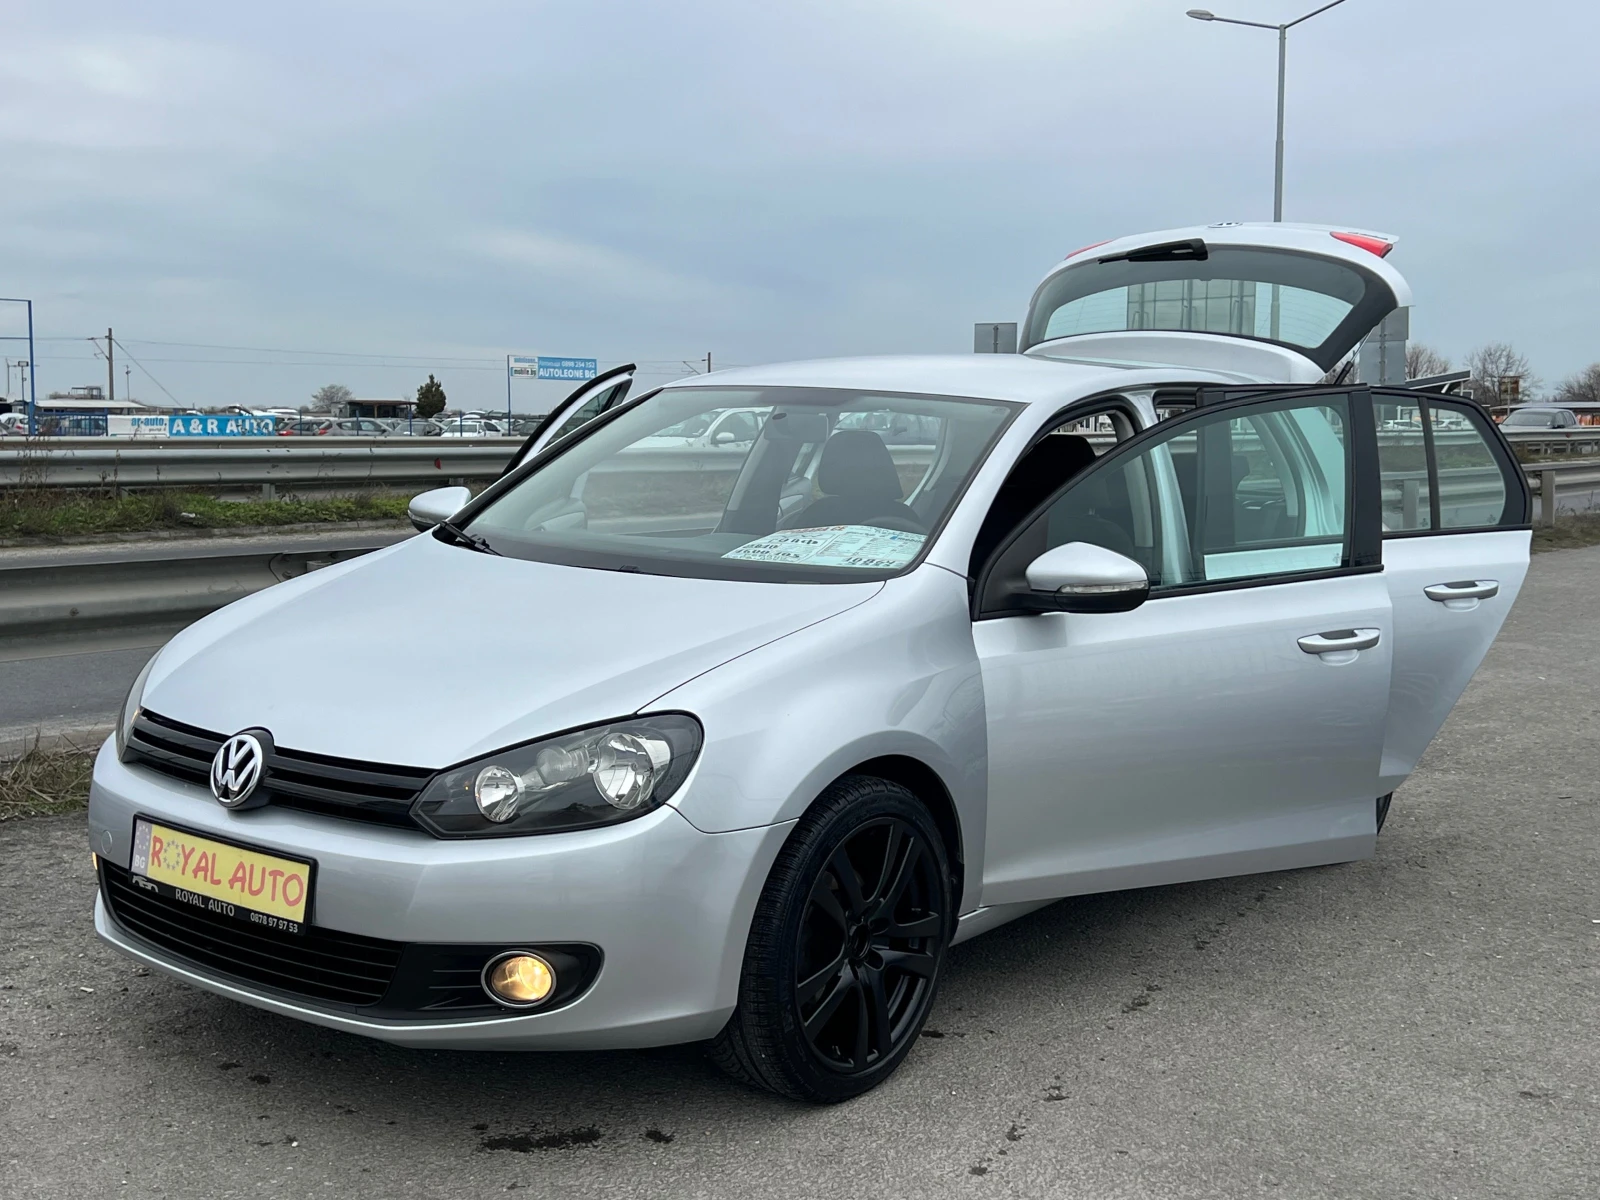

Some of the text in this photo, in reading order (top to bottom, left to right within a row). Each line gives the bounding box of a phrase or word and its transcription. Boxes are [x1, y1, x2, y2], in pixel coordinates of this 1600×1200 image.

[539, 367, 596, 379] AUTOLEONE BG
[172, 418, 274, 434] A & R AUTO
[134, 854, 146, 869] BG
[228, 861, 304, 907] AUTO
[175, 888, 235, 917] ROYAL AUTO
[250, 912, 299, 934] 0878 97 97 53
